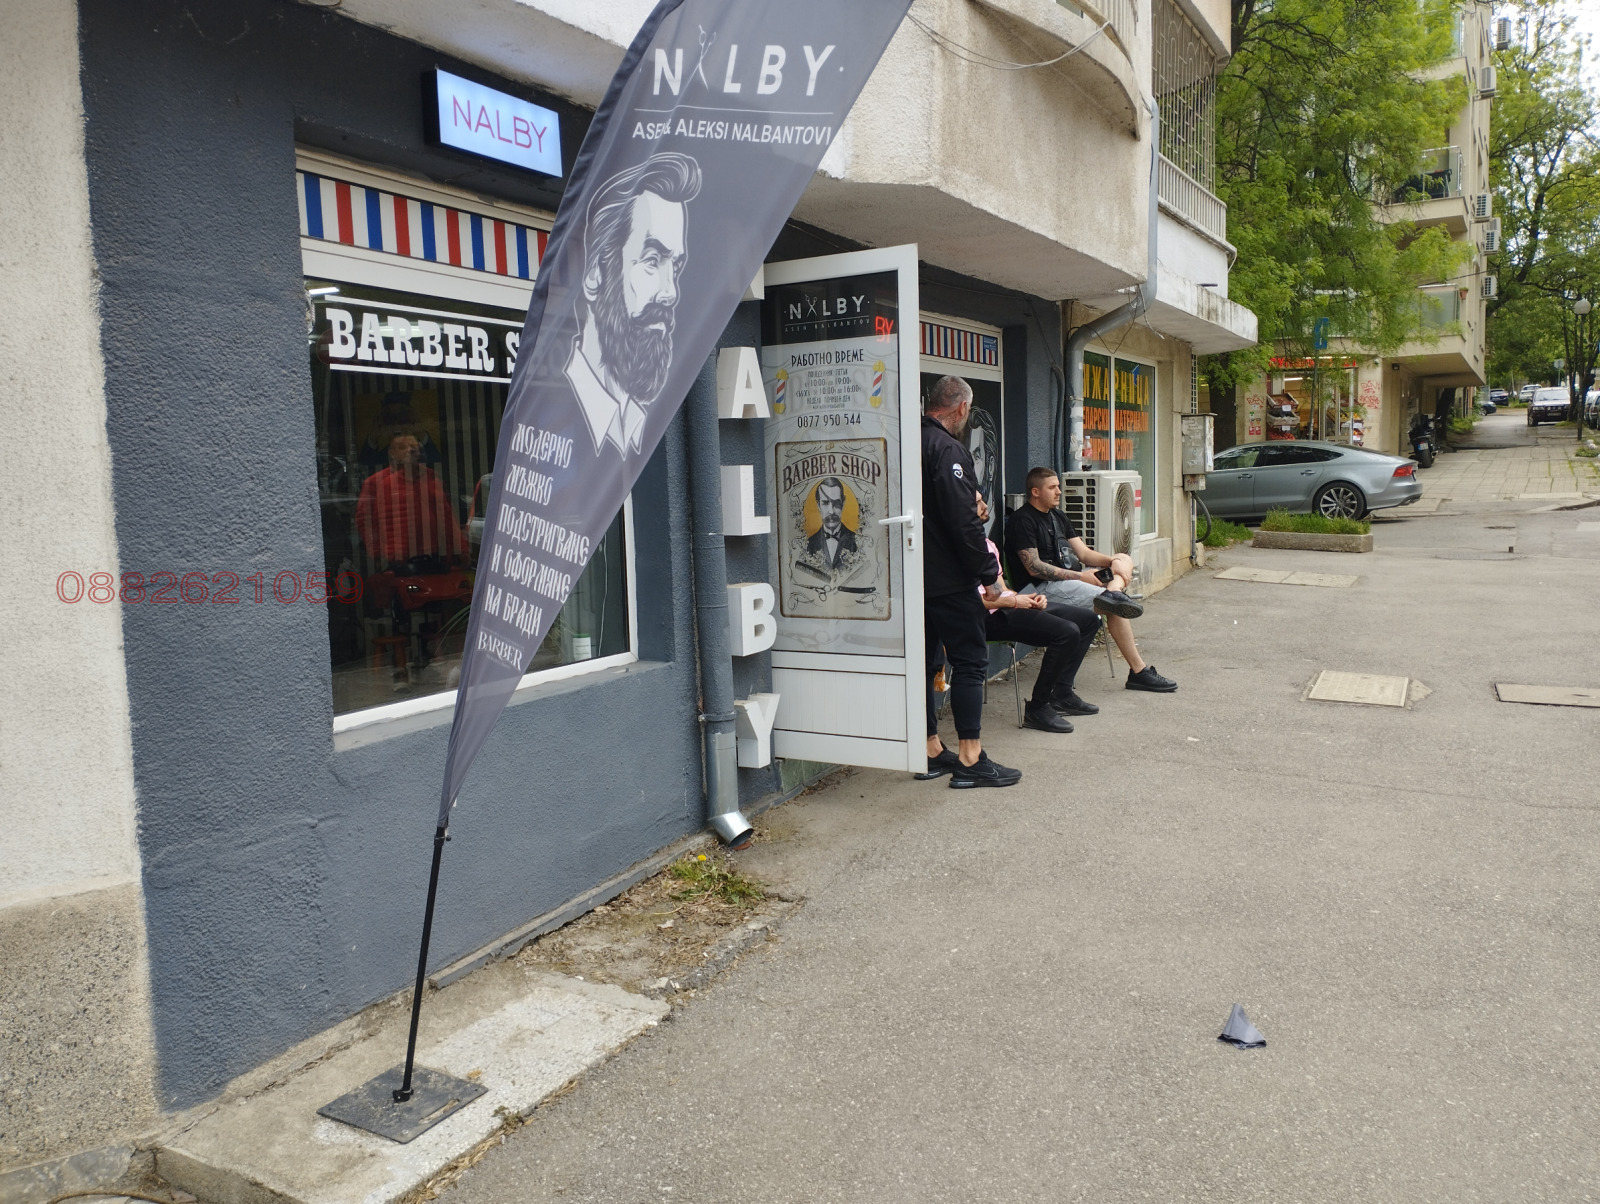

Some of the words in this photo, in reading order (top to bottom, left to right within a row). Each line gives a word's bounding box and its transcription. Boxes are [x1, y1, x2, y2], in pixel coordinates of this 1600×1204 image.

[452, 94, 548, 153] NALBY
[675, 118, 729, 140] ALEKSI
[731, 122, 832, 146] NALBANTOVI
[325, 307, 494, 373] BARBER
[791, 351, 833, 368] РАБОТНО
[835, 348, 865, 364] ВРЕМЕ
[797, 416, 820, 428] 0877
[823, 413, 840, 426] 950
[844, 412, 861, 425] 544
[511, 423, 574, 469] МОДЕРНО
[505, 464, 554, 506] МЪЖКО
[782, 453, 837, 494] BARBER
[841, 454, 882, 487] SHOP
[497, 503, 590, 567] ПОДСТРИГВАНЕ
[491, 543, 502, 573] И
[503, 548, 571, 604] ОФОРМЯНЕ
[484, 583, 502, 617] НА
[502, 592, 543, 640] БРАДИ
[477, 631, 522, 671] BARBER
